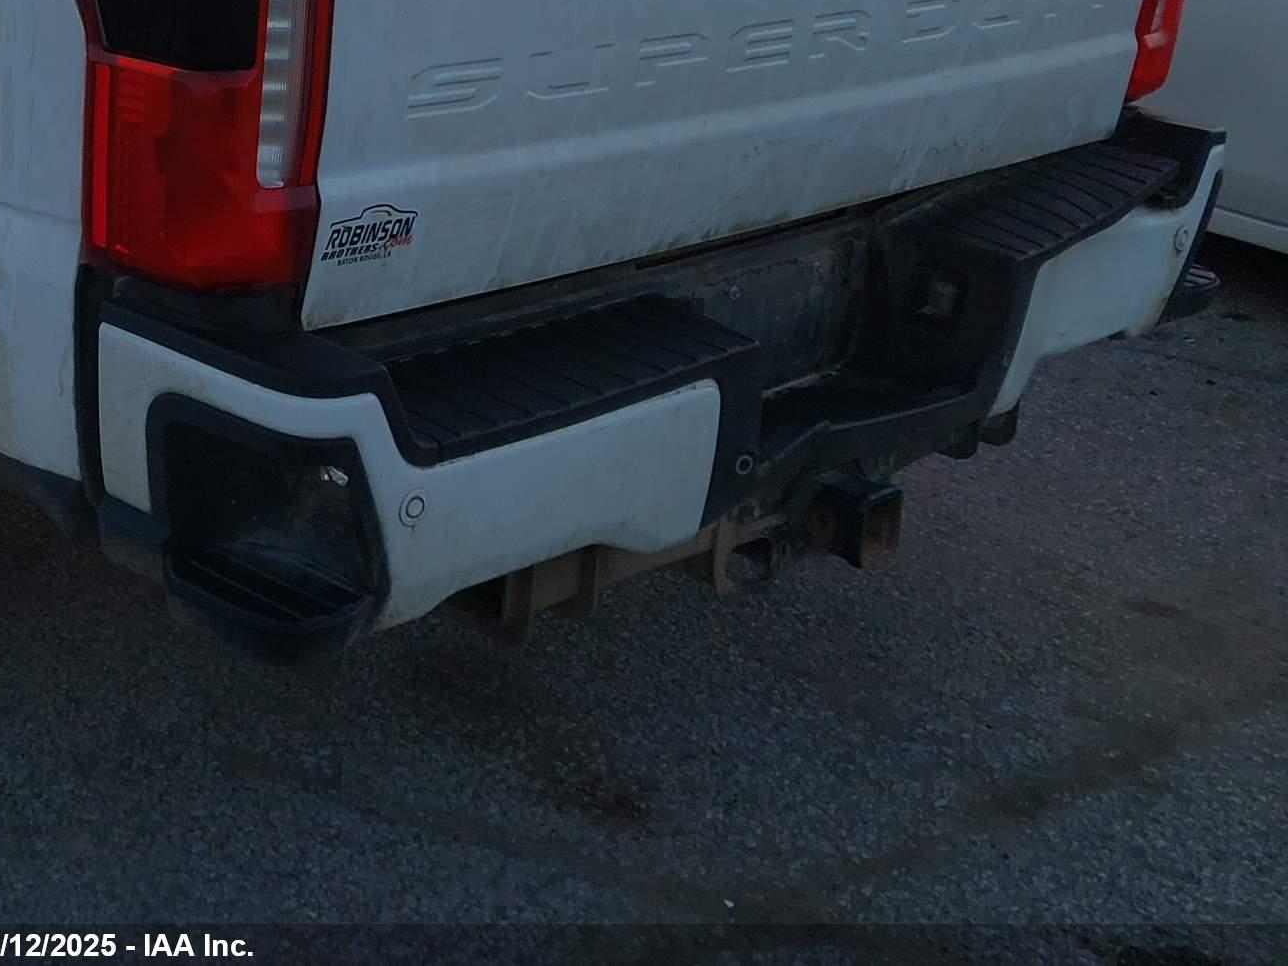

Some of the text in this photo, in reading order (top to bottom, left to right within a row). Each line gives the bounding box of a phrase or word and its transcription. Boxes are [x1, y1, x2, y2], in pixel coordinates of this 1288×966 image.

[405, 8, 873, 121] SUPER
[325, 216, 416, 250] ROBINSON
[337, 257, 359, 266] BATON
